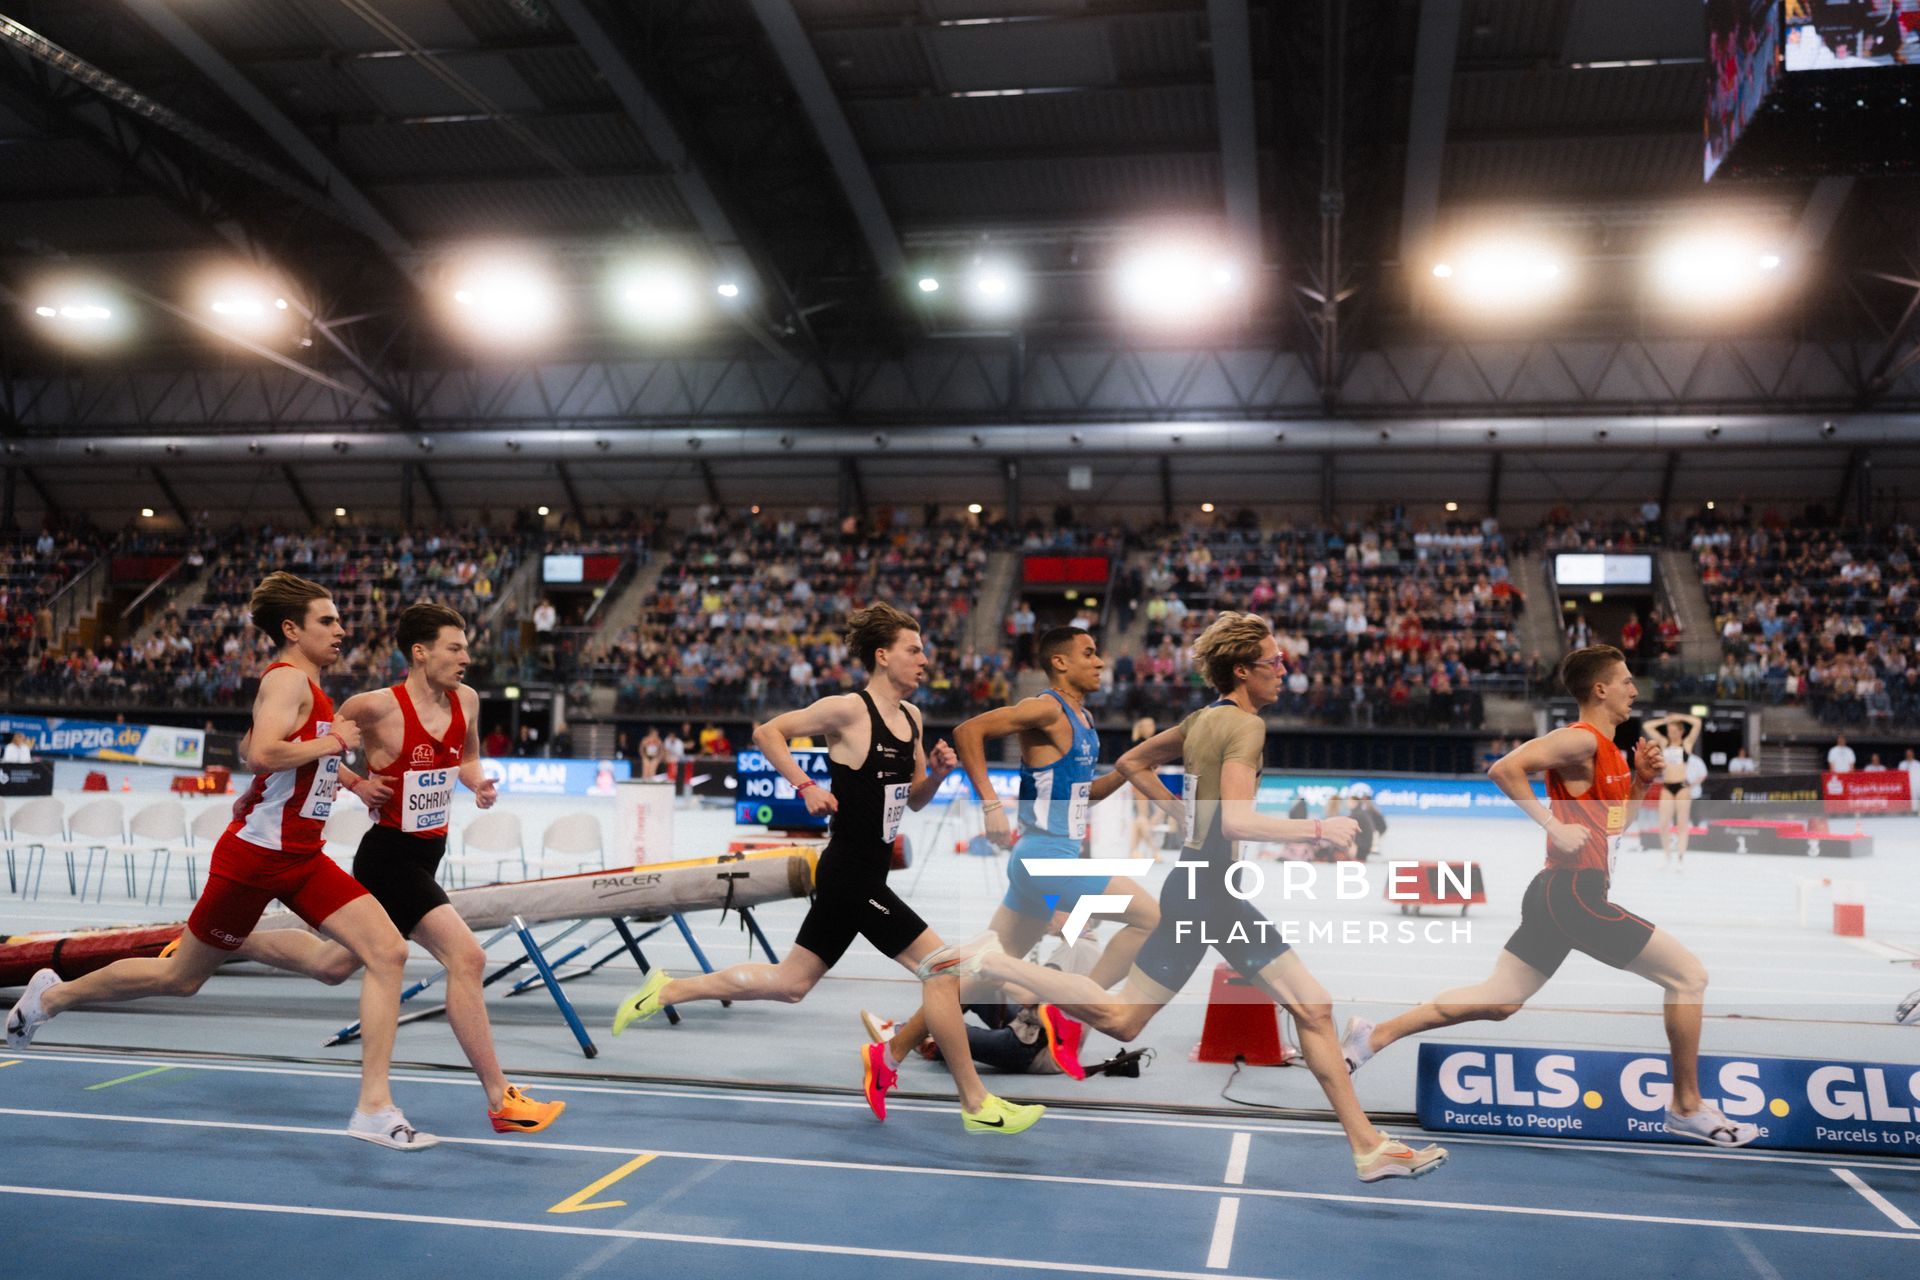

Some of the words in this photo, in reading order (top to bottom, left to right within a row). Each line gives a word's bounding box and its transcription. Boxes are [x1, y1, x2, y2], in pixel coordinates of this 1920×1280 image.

[418, 771, 447, 787] GLS
[746, 778, 774, 797] NO
[1736, 836, 1748, 854] 1
[592, 873, 662, 890] PACER
[1438, 1051, 1603, 1110] GLS.
[1444, 1110, 1502, 1126] Parcels
[1507, 1113, 1524, 1127] to
[1528, 1114, 1582, 1132] People
[1816, 1127, 1878, 1143] Parcels
[1881, 1131, 1900, 1144] to
